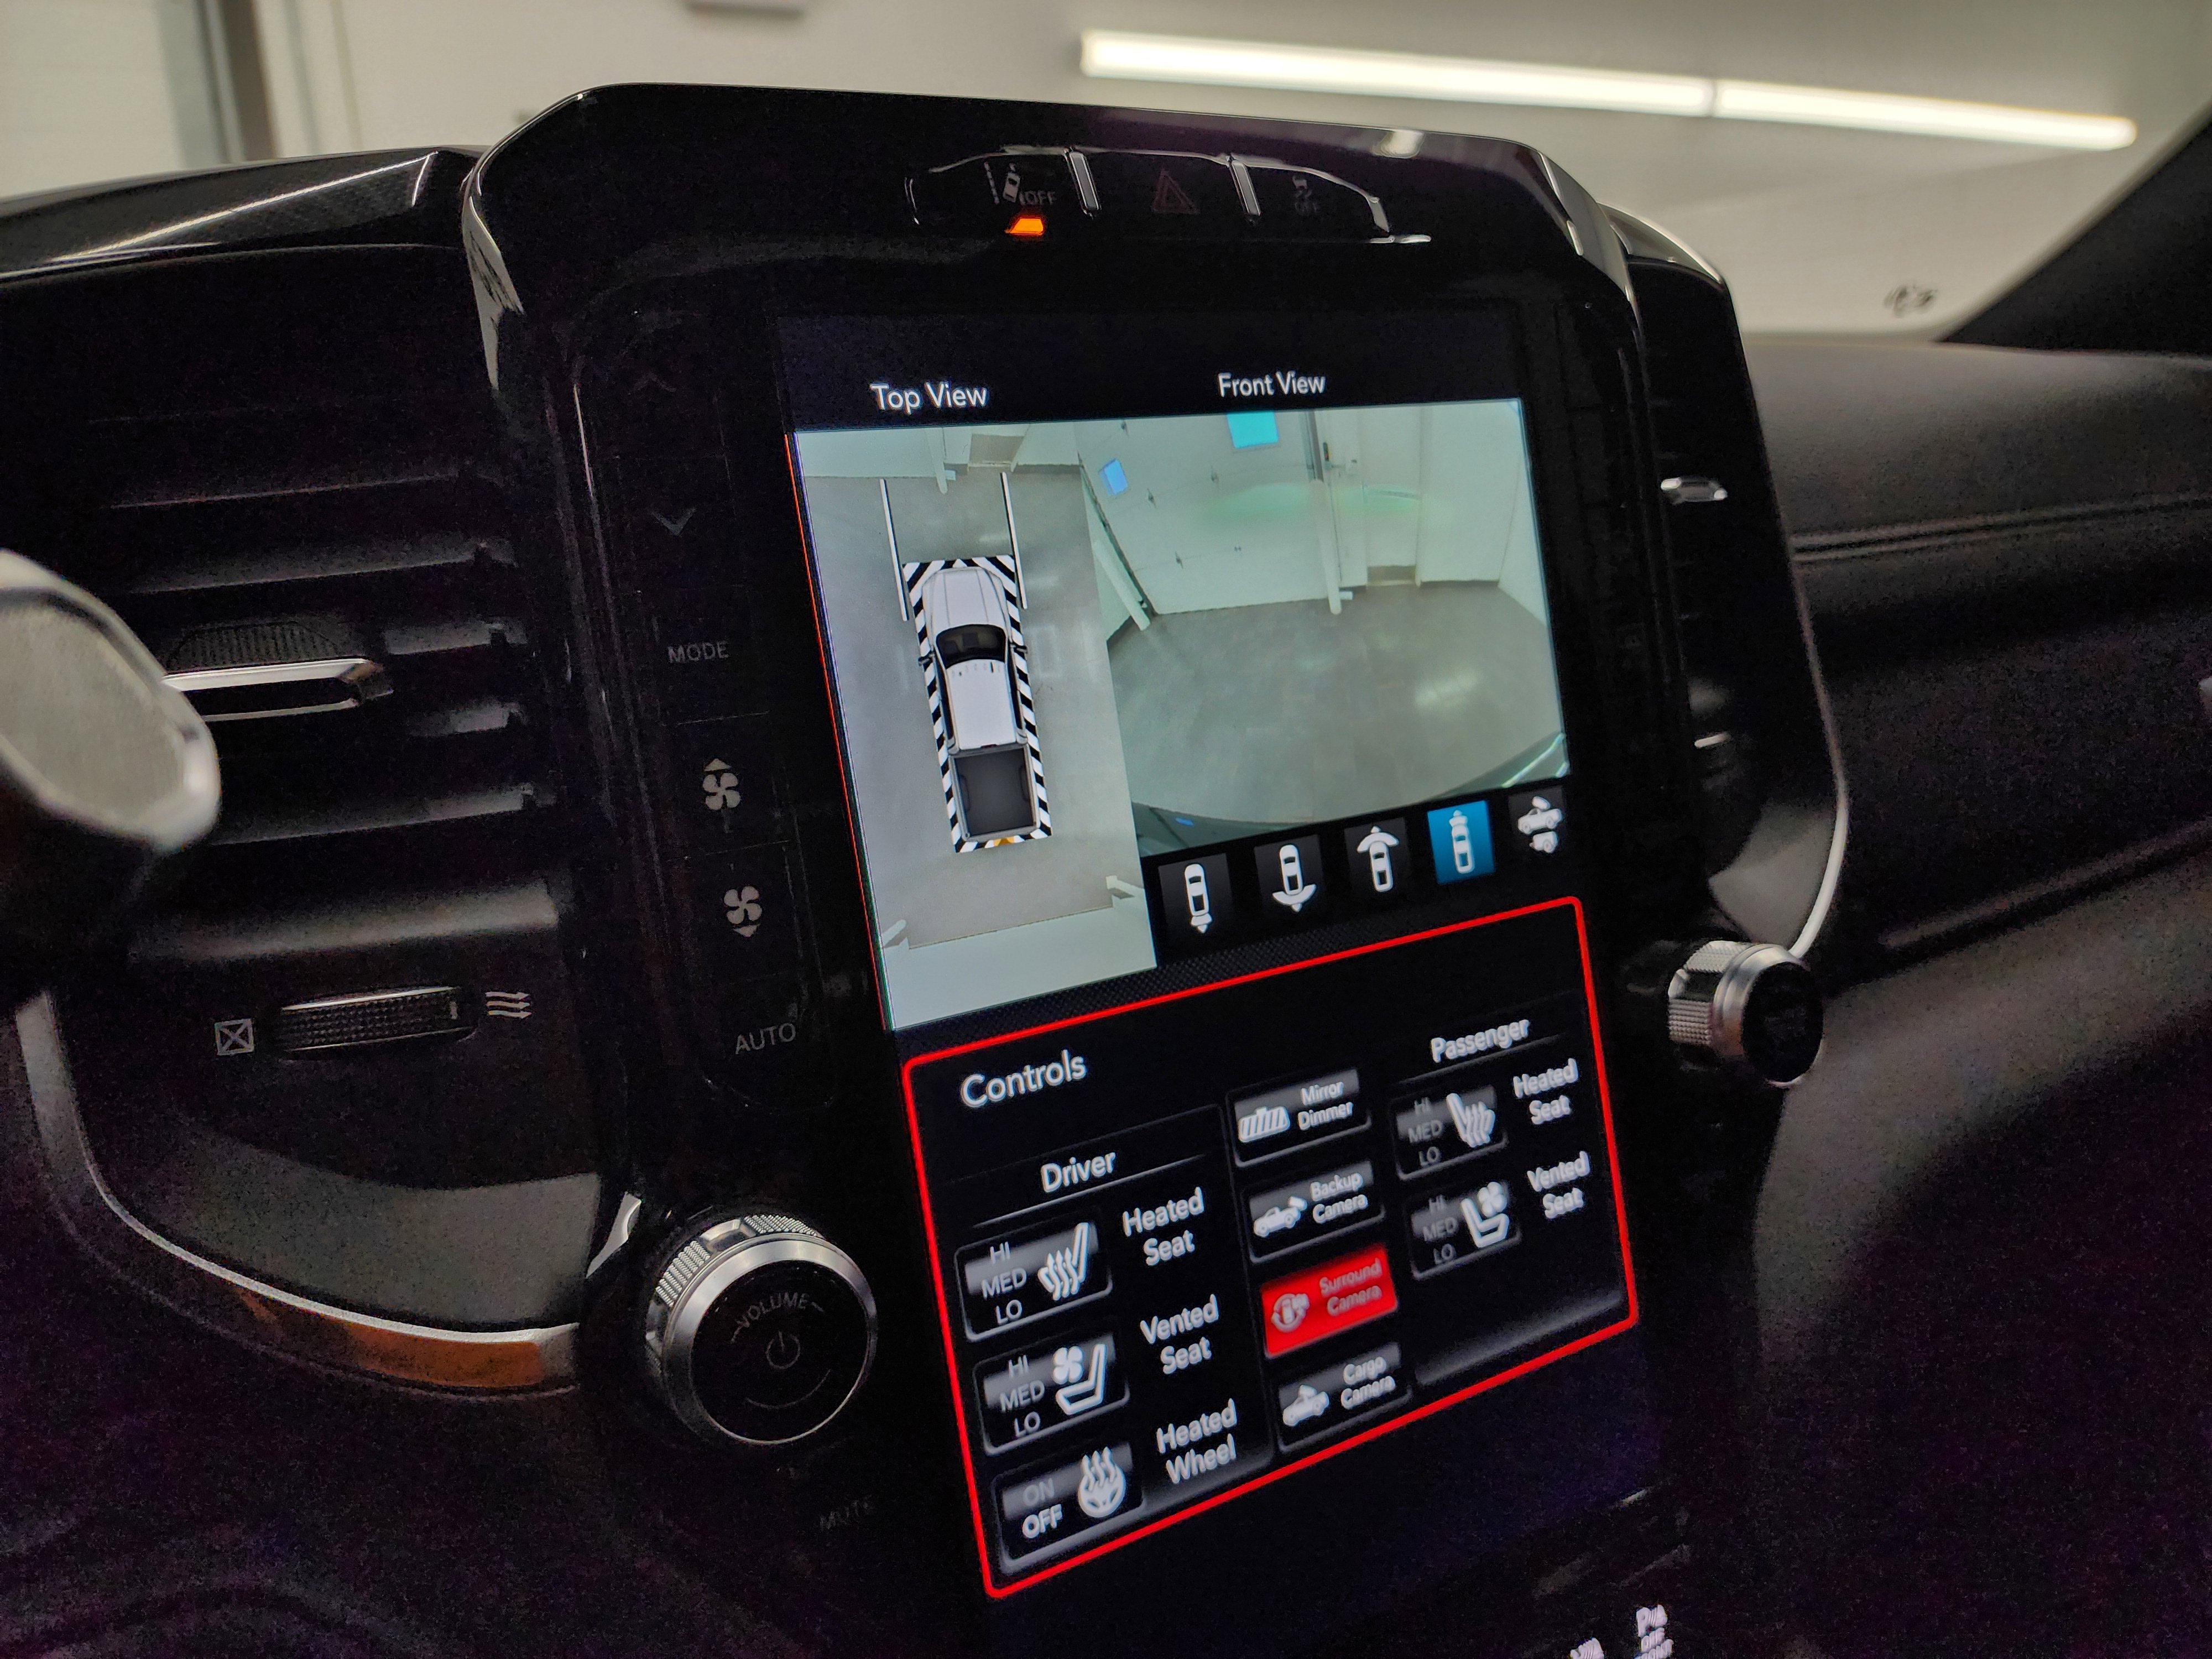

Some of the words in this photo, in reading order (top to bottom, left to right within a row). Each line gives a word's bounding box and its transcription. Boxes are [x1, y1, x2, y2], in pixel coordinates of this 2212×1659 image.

[870, 382, 922, 415] Top
[924, 380, 989, 409] View
[1217, 372, 1274, 398] Front
[1274, 371, 1326, 395] View
[667, 640, 731, 663] MODE
[735, 1022, 797, 1055] AUTO
[1431, 1019, 1530, 1063] Passenger
[961, 1048, 1087, 1108] Controls
[1300, 1082, 1344, 1105] Mirror
[1512, 1058, 1580, 1099] Heated
[1297, 1101, 1354, 1131] Dimmer
[1528, 1094, 1572, 1125] Seat
[1408, 1120, 1442, 1143] MED
[1418, 1146, 1441, 1166] LO
[1527, 1150, 1591, 1192] Vented
[1040, 1152, 1117, 1193] Driver
[1311, 1172, 1363, 1202] Backup
[1122, 1186, 1206, 1238] Heated
[1312, 1194, 1368, 1224] Camera
[1542, 1187, 1584, 1220] Seat
[1422, 1217, 1459, 1241] MED
[989, 1241, 1011, 1264] HI
[1143, 1229, 1196, 1266] Seat
[1433, 1244, 1455, 1265] LO
[982, 1268, 1027, 1300] MED
[1319, 1258, 1382, 1298] Surround
[734, 1292, 810, 1329] VOLUME
[995, 1300, 1023, 1325] LO
[1327, 1285, 1382, 1317] Camera
[1139, 1293, 1219, 1345] Vented
[1008, 1355, 1030, 1378] HI
[1160, 1336, 1212, 1375] Seat
[1343, 1356, 1387, 1385] Cargo
[999, 1380, 1045, 1413] MED
[1340, 1375, 1396, 1410] Camera
[1014, 1411, 1041, 1437] LO
[1156, 1397, 1238, 1454] Heated
[1166, 1433, 1237, 1484] Wheel
[1022, 1477, 1055, 1506] ON
[1022, 1504, 1062, 1538] OFF
